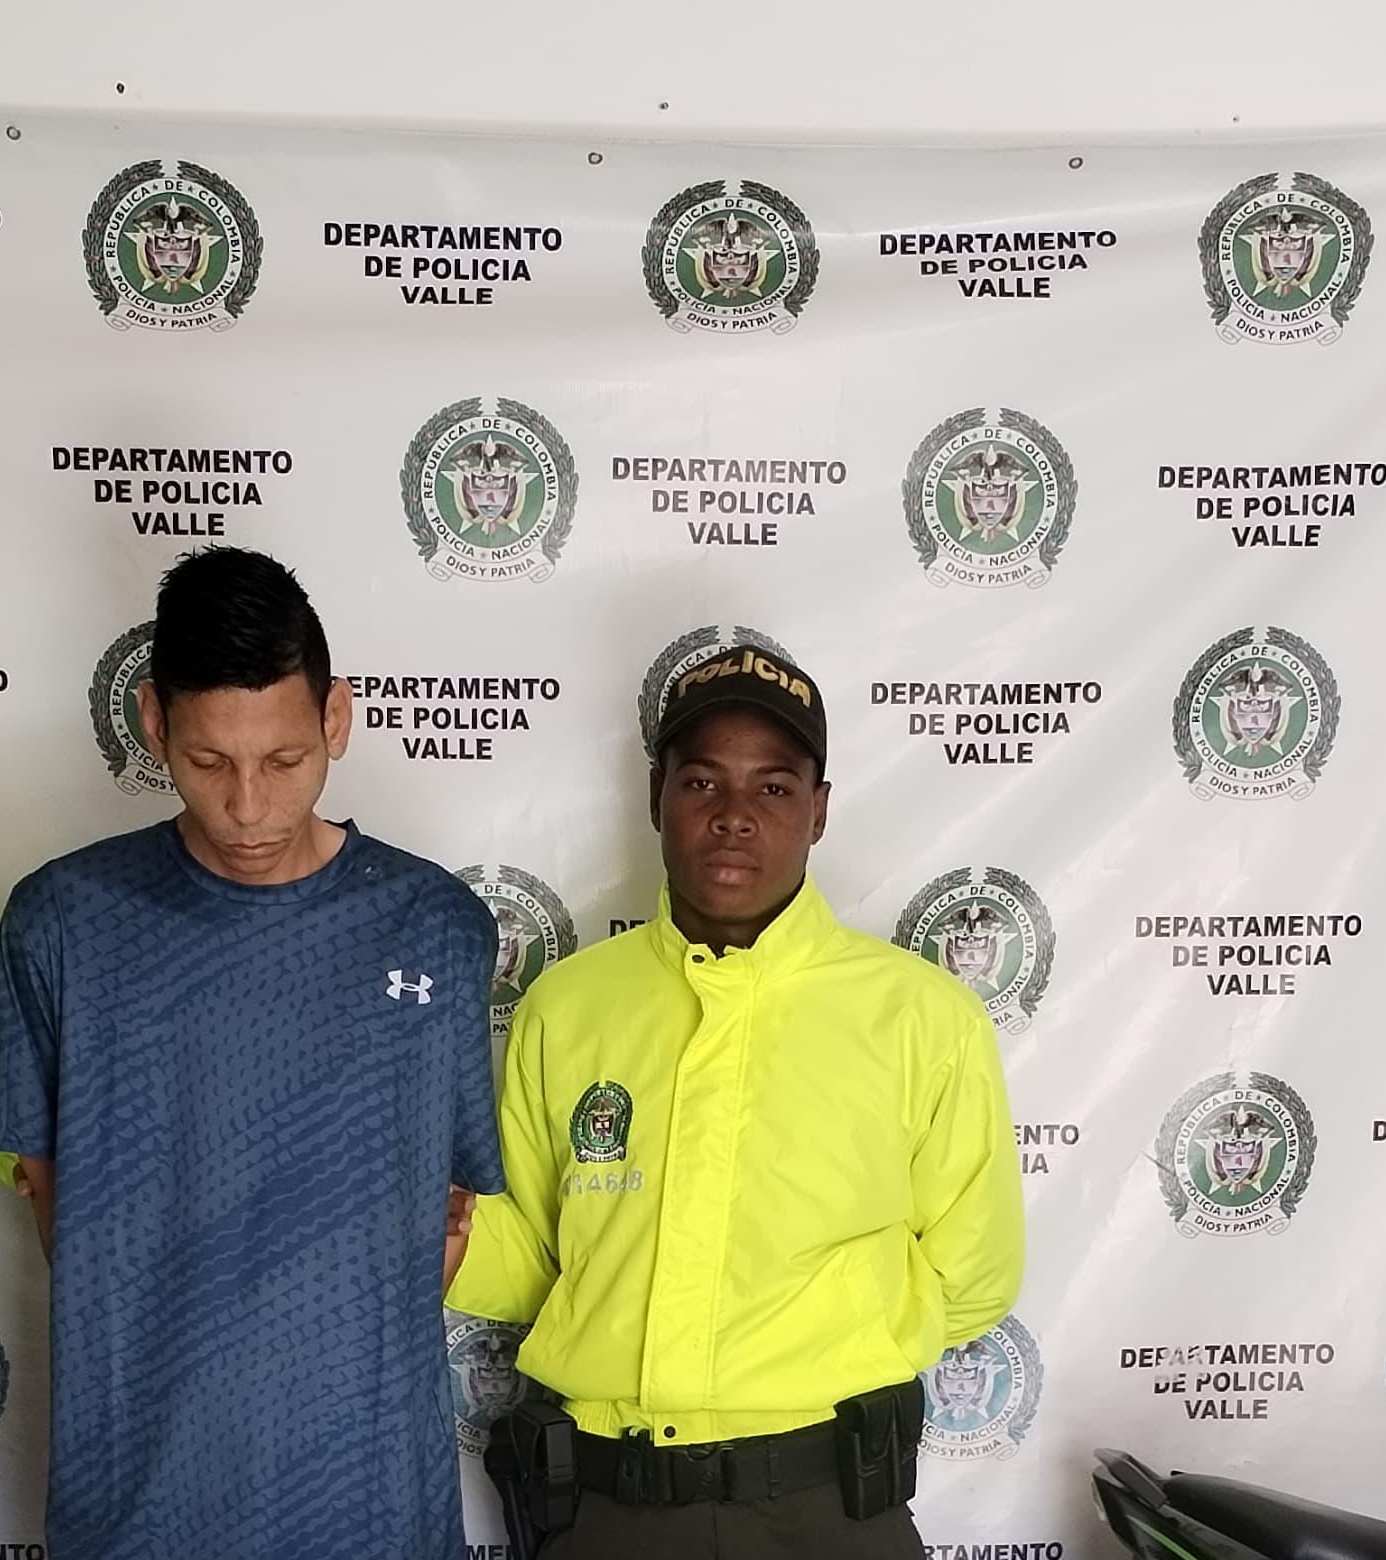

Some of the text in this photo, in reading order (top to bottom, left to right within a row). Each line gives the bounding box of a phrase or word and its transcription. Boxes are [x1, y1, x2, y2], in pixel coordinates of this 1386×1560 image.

[324, 222, 562, 252] DEPARTAMENTO
[879, 230, 1117, 256] DEPARTAMENTO
[364, 255, 532, 282] DE POLICIA
[920, 253, 1088, 276] DE POLICIA
[400, 285, 494, 305] VALLE
[957, 276, 1051, 299] VALLE
[52, 446, 293, 474] DEPARTAMENTO
[612, 457, 847, 485] DEPARTAMENTO
[93, 479, 263, 506] DE POLICIA
[652, 489, 815, 516] DE POLICIA
[1196, 493, 1355, 520] DE POLICIA
[131, 511, 225, 537] VALLE
[687, 522, 778, 546] VALLE
[1231, 524, 1322, 548] VALLE
[330, 675, 561, 701] EPARTAMENTO
[677, 649, 812, 708] POLICIA
[871, 681, 1102, 706] DEPARTAMENTO
[366, 706, 530, 730] DE POLICIA
[909, 711, 1070, 736] DE POLICIA
[401, 737, 493, 761] VALLE
[943, 742, 1033, 765] VALLE
[1136, 914, 1362, 938] DEPARTAMENTO
[1172, 944, 1332, 967] DE POLICIA
[1206, 973, 1297, 996] VALLE
